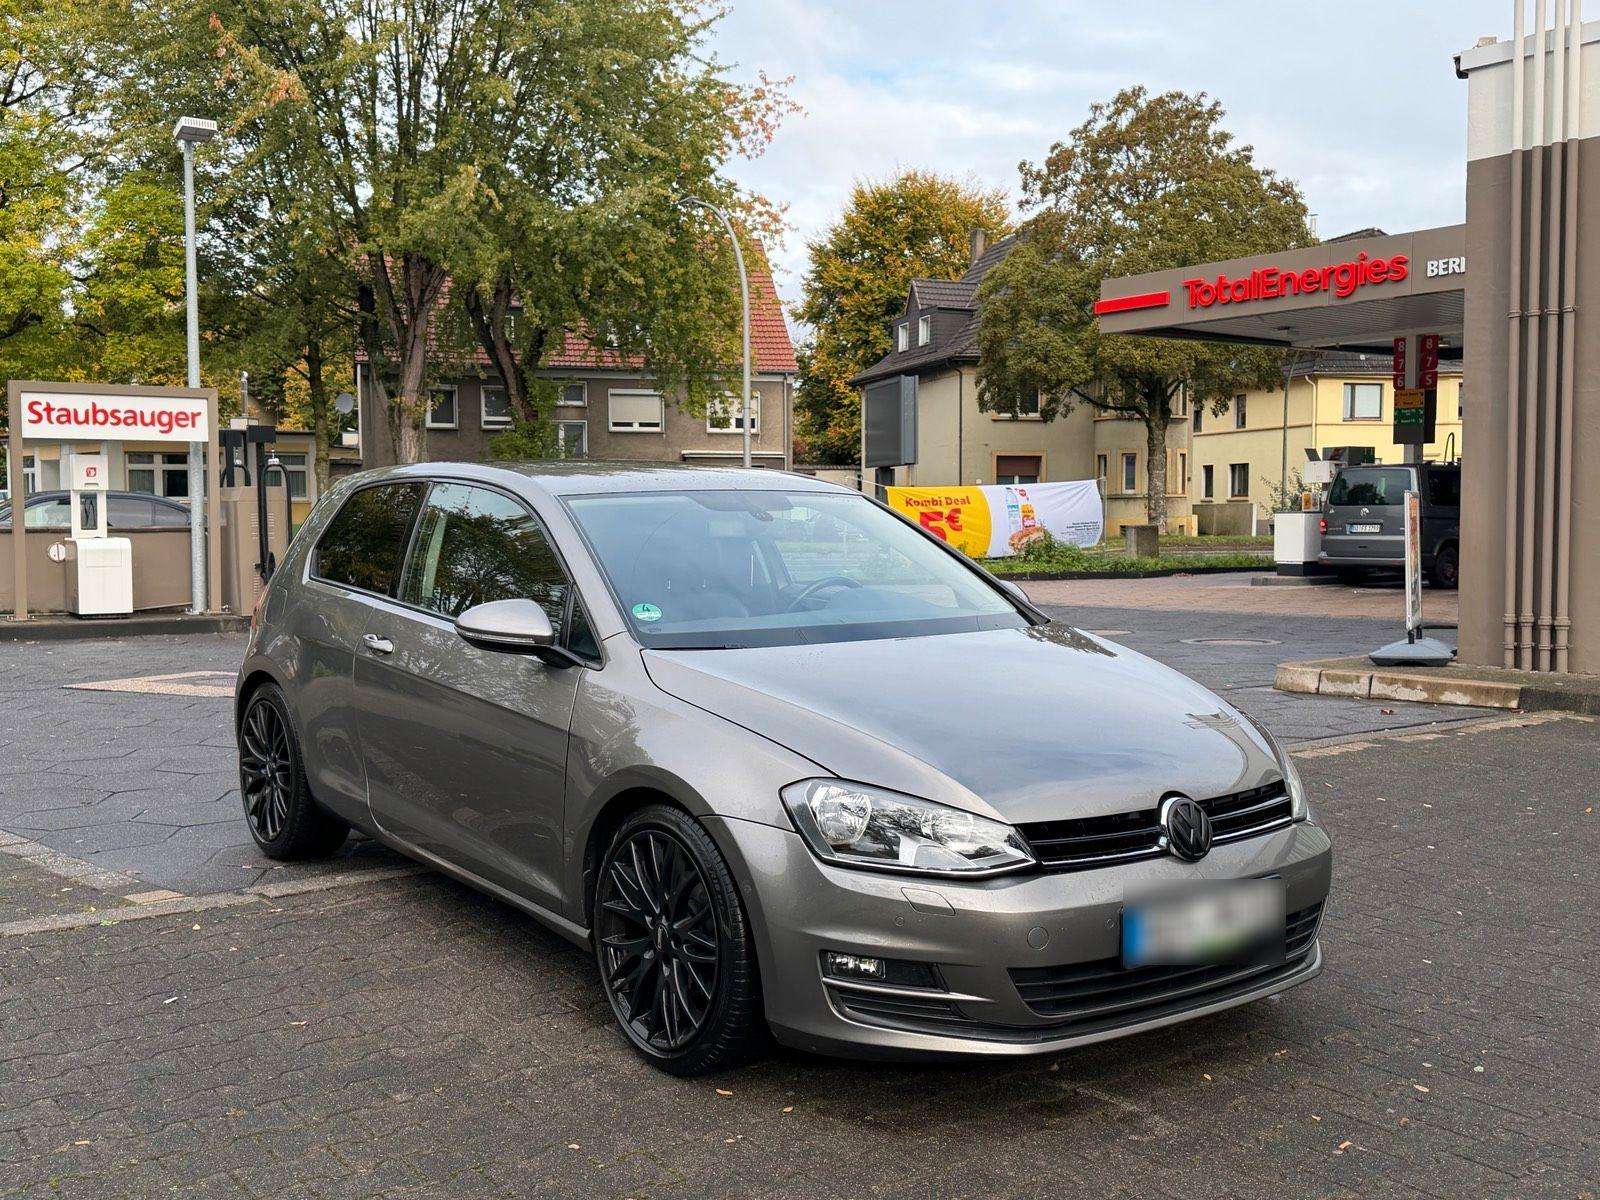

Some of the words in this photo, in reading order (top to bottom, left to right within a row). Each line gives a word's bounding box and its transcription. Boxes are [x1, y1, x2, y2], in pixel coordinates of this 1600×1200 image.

[1183, 251, 1409, 308] TotalEnergies
[1398, 341, 1405, 352] 8
[1426, 338, 1433, 349] 8
[1398, 359, 1405, 370] 7
[1426, 356, 1432, 367] 7
[1397, 376, 1404, 387] 6
[1425, 375, 1432, 385] 5
[27, 400, 202, 434] Staubsauger
[905, 497, 943, 507] Kombi
[944, 495, 971, 505] Deal
